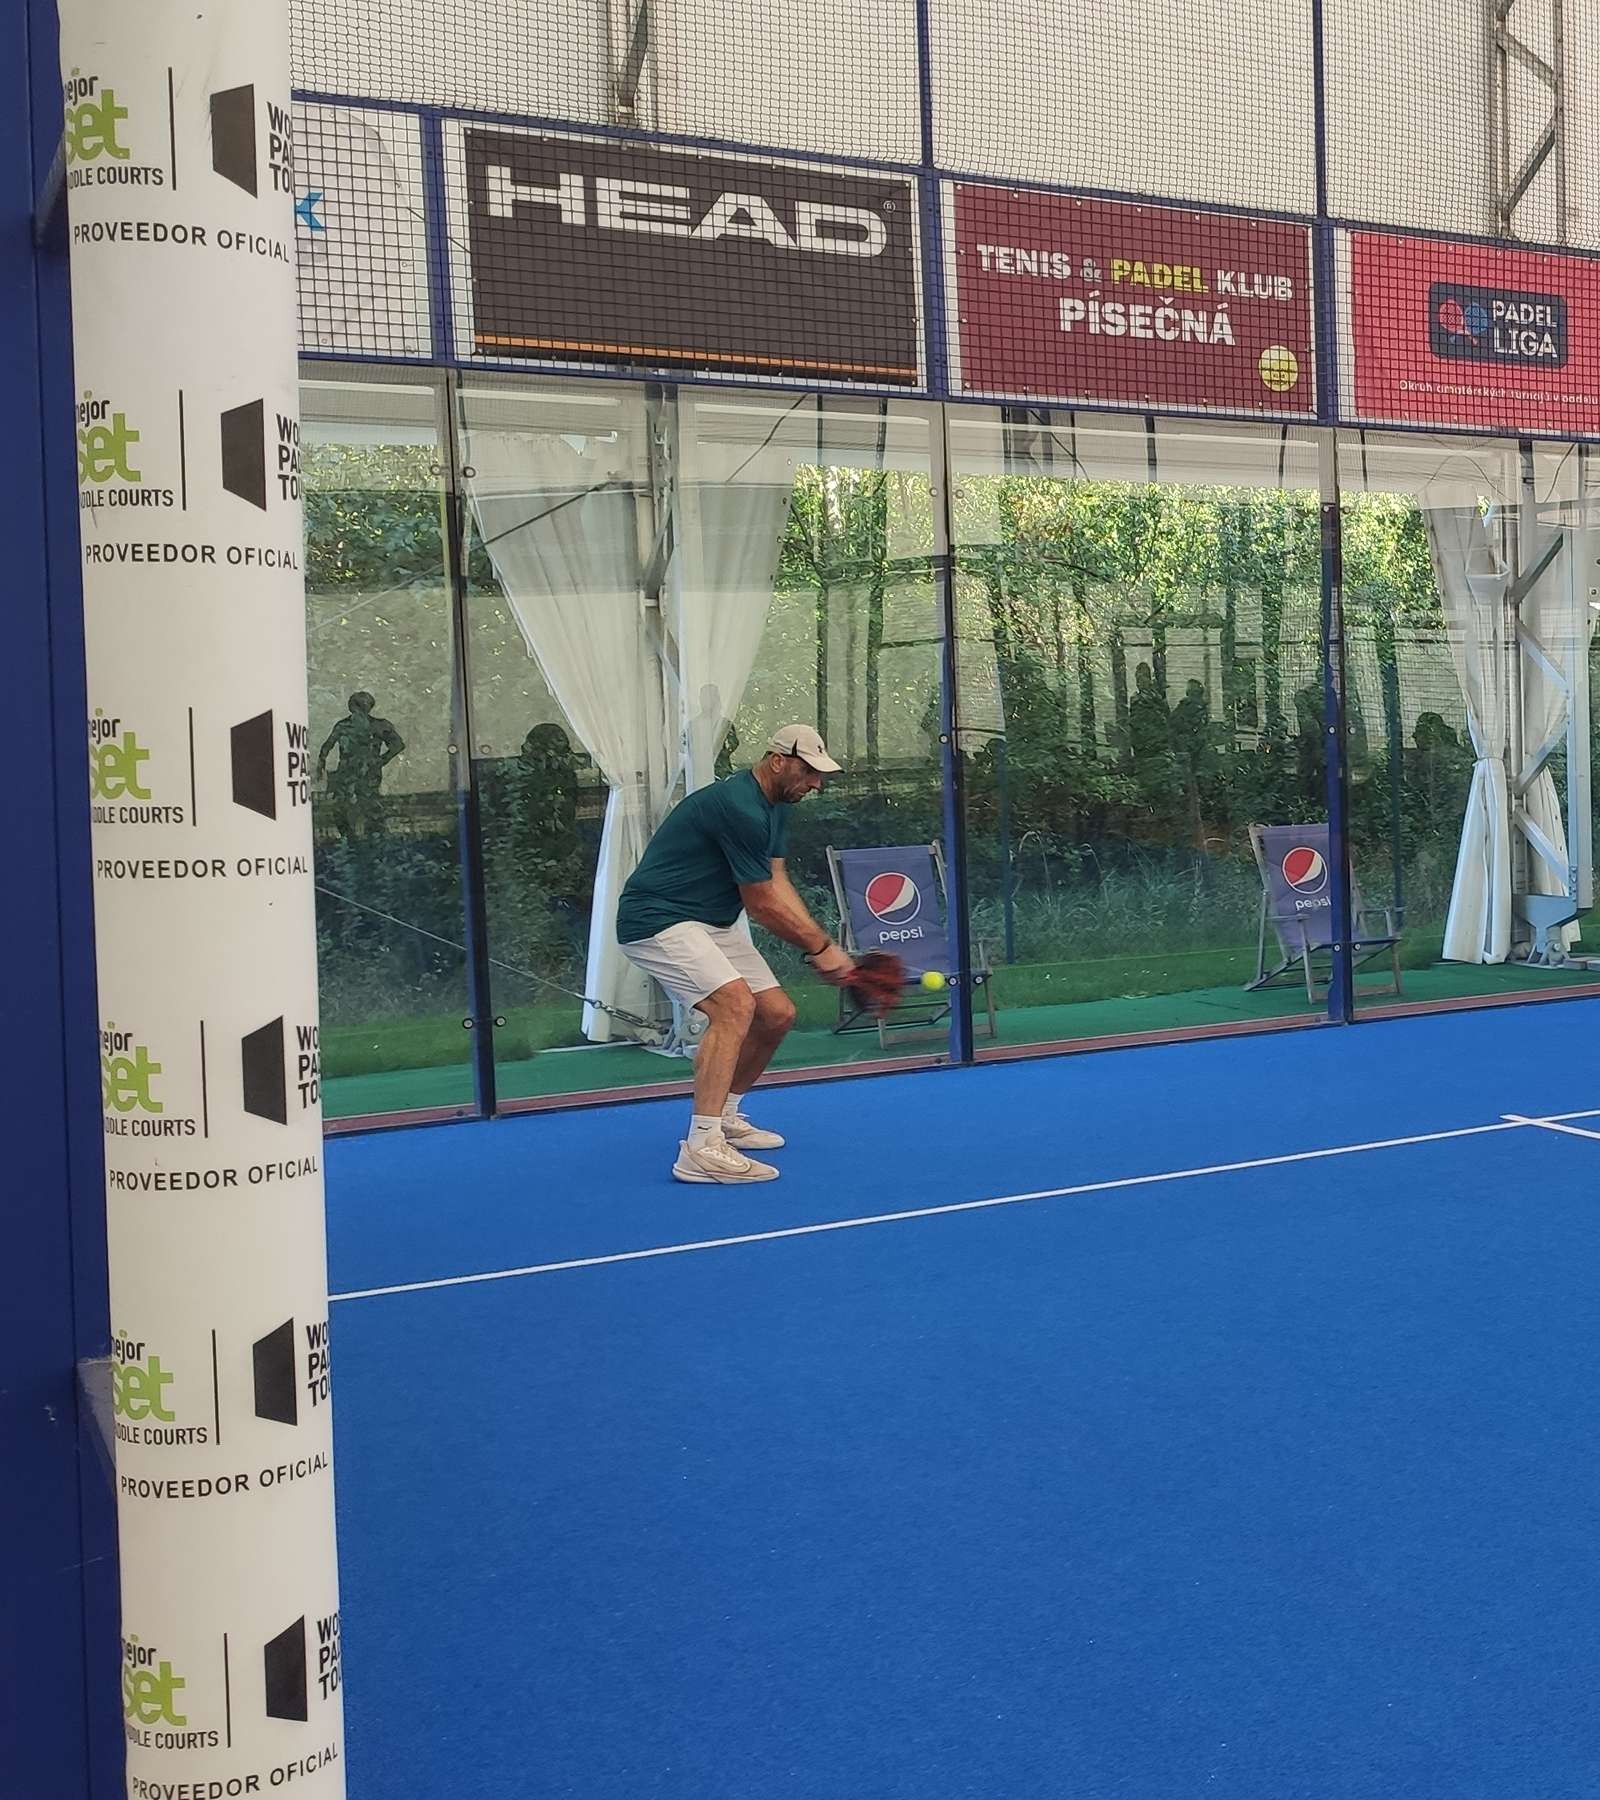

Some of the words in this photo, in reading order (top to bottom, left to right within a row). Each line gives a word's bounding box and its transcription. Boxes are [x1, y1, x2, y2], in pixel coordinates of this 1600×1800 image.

[97, 166, 163, 186] COURTS
[269, 163, 294, 194] TO
[485, 164, 887, 258] HEAD
[74, 222, 207, 246] PROVEEDOR
[217, 230, 289, 263] OFICIAL
[976, 244, 1072, 280] TENIS
[1079, 258, 1102, 283] &
[1110, 258, 1209, 293] PADEL
[1217, 269, 1293, 301] KLUB
[1058, 290, 1235, 346] PÍSEČNÁ
[1493, 300, 1557, 327] PADEL
[1494, 328, 1557, 358] LIGA
[109, 489, 174, 507] COURTS
[277, 474, 301, 501] TO
[86, 543, 216, 565] PROVEEDOR
[226, 546, 298, 570] OFICIAL
[287, 780, 311, 807] TO
[119, 806, 184, 824] COURTS
[97, 859, 227, 879] PROVEEDOR
[236, 856, 308, 877] OFICIAL
[879, 926, 924, 944] pepsi
[298, 1081, 321, 1109] TO
[131, 1119, 196, 1137] COURTS
[110, 1169, 238, 1191] PROVEEDOR
[248, 1155, 318, 1184] OFICIAL
[307, 1372, 331, 1407] TO
[143, 1427, 208, 1445] COURTS
[121, 1474, 250, 1500] PROVEEDOR
[259, 1451, 328, 1488] OFICIAL
[318, 1666, 341, 1701] TO
[155, 1730, 219, 1750] COURTS
[132, 1774, 260, 1800] PROVEEDOR
[269, 1742, 338, 1787] OFICIAL
